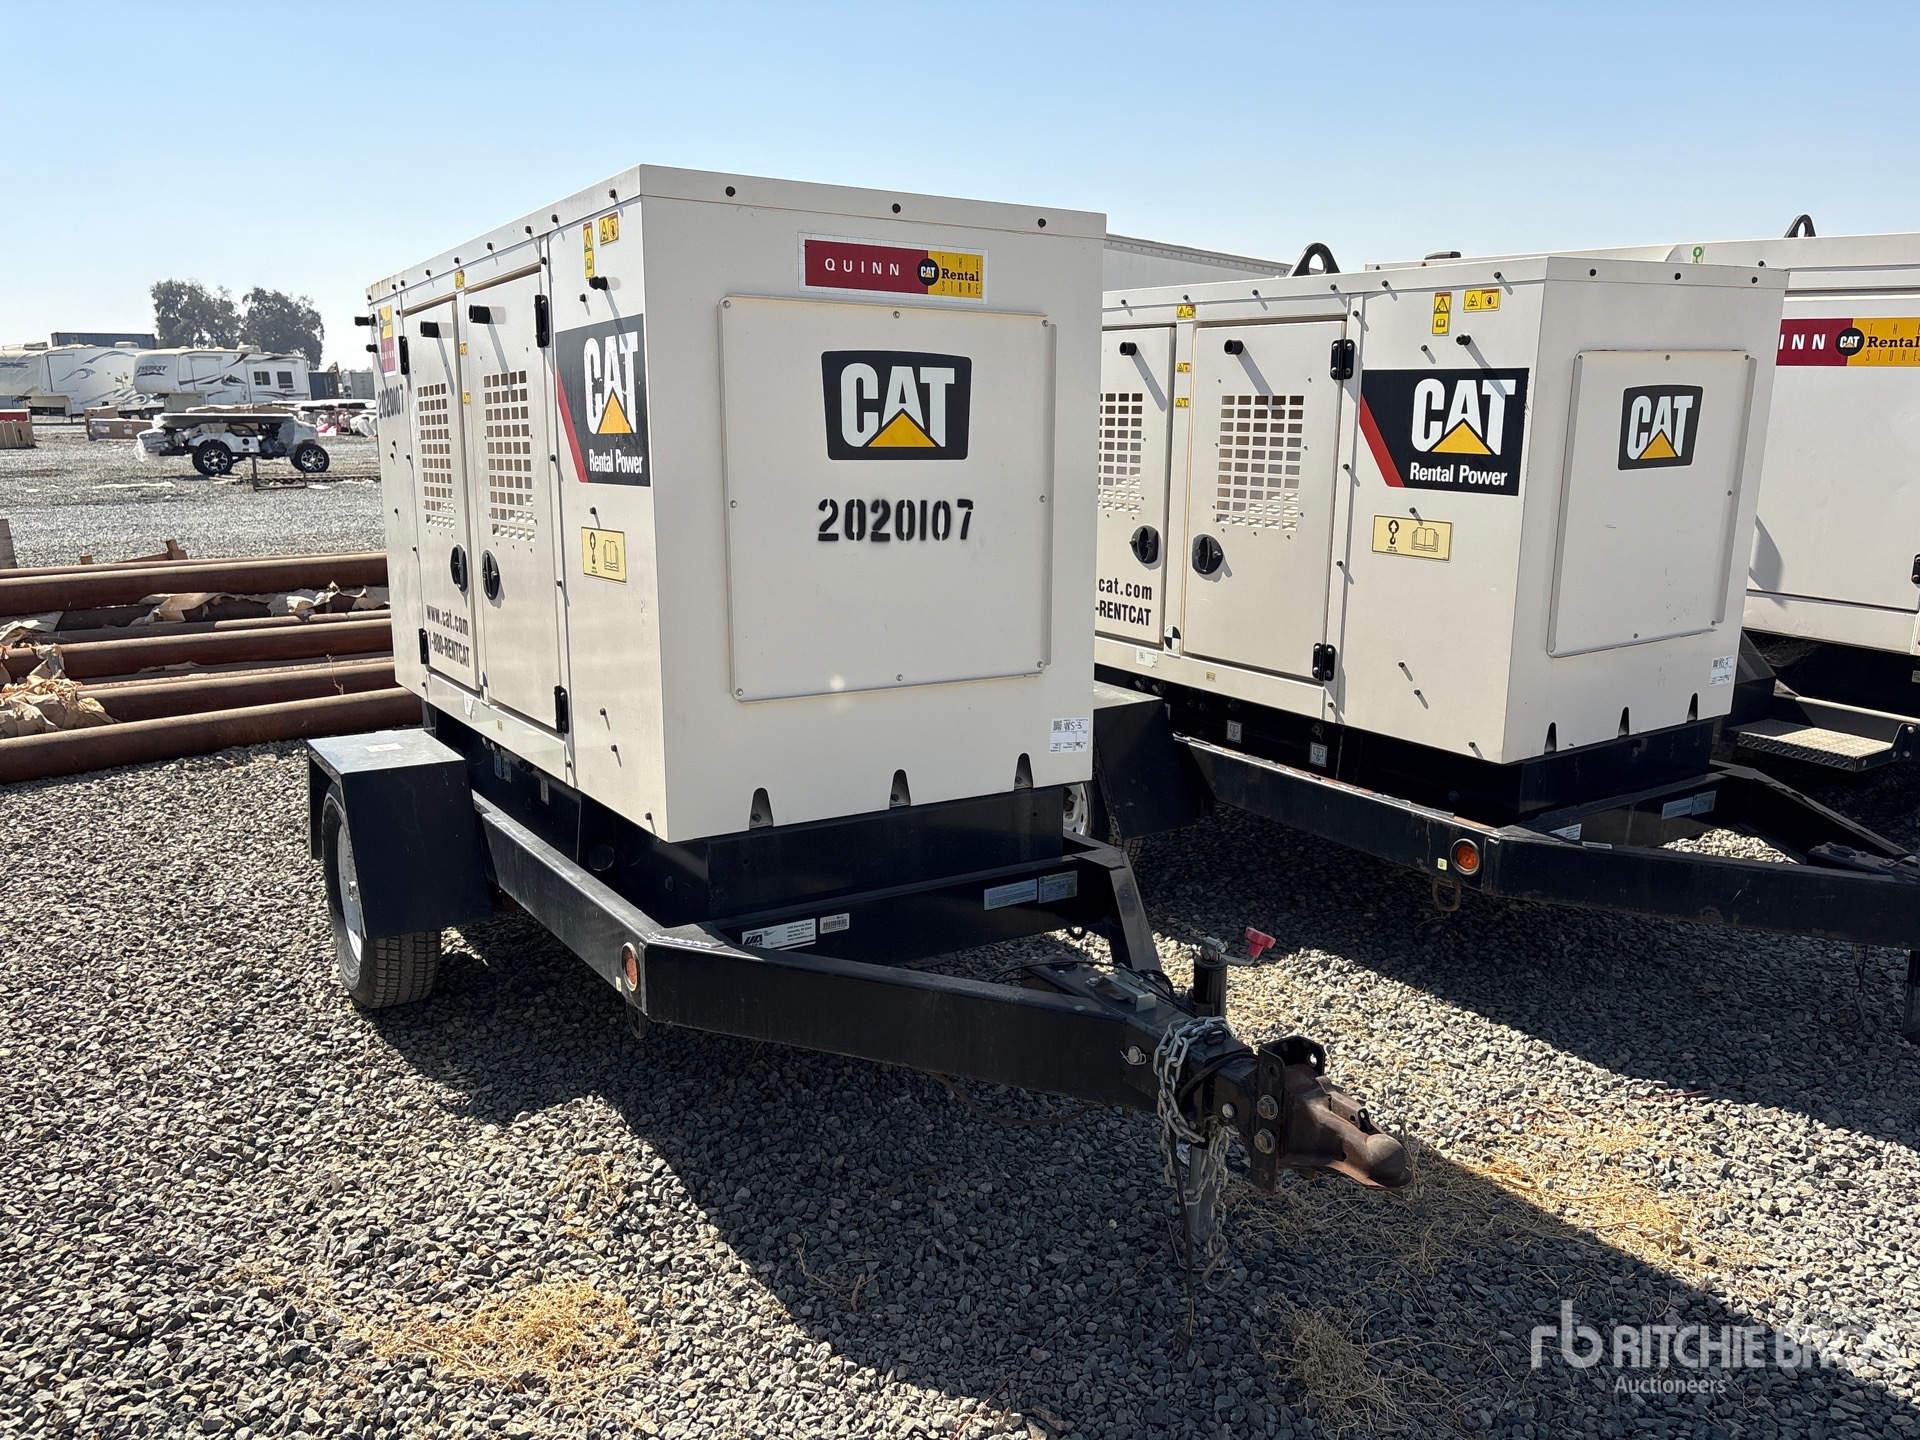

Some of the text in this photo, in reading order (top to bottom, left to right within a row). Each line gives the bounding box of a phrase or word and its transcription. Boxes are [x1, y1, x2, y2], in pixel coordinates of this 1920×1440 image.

[825, 258, 899, 276] QUINN
[920, 266, 936, 278] CAT
[941, 255, 980, 268] THE
[941, 268, 980, 282] Rental
[1839, 336, 1860, 348] CAT
[1866, 336, 1920, 348] Rental
[584, 331, 638, 434] CAT
[840, 363, 955, 448] CAT
[1411, 378, 1517, 456] CAT
[1627, 395, 1693, 460] CAT
[589, 448, 643, 474] Rental Power
[1410, 462, 1508, 486] Rental Power
[818, 499, 974, 541] 2020107
